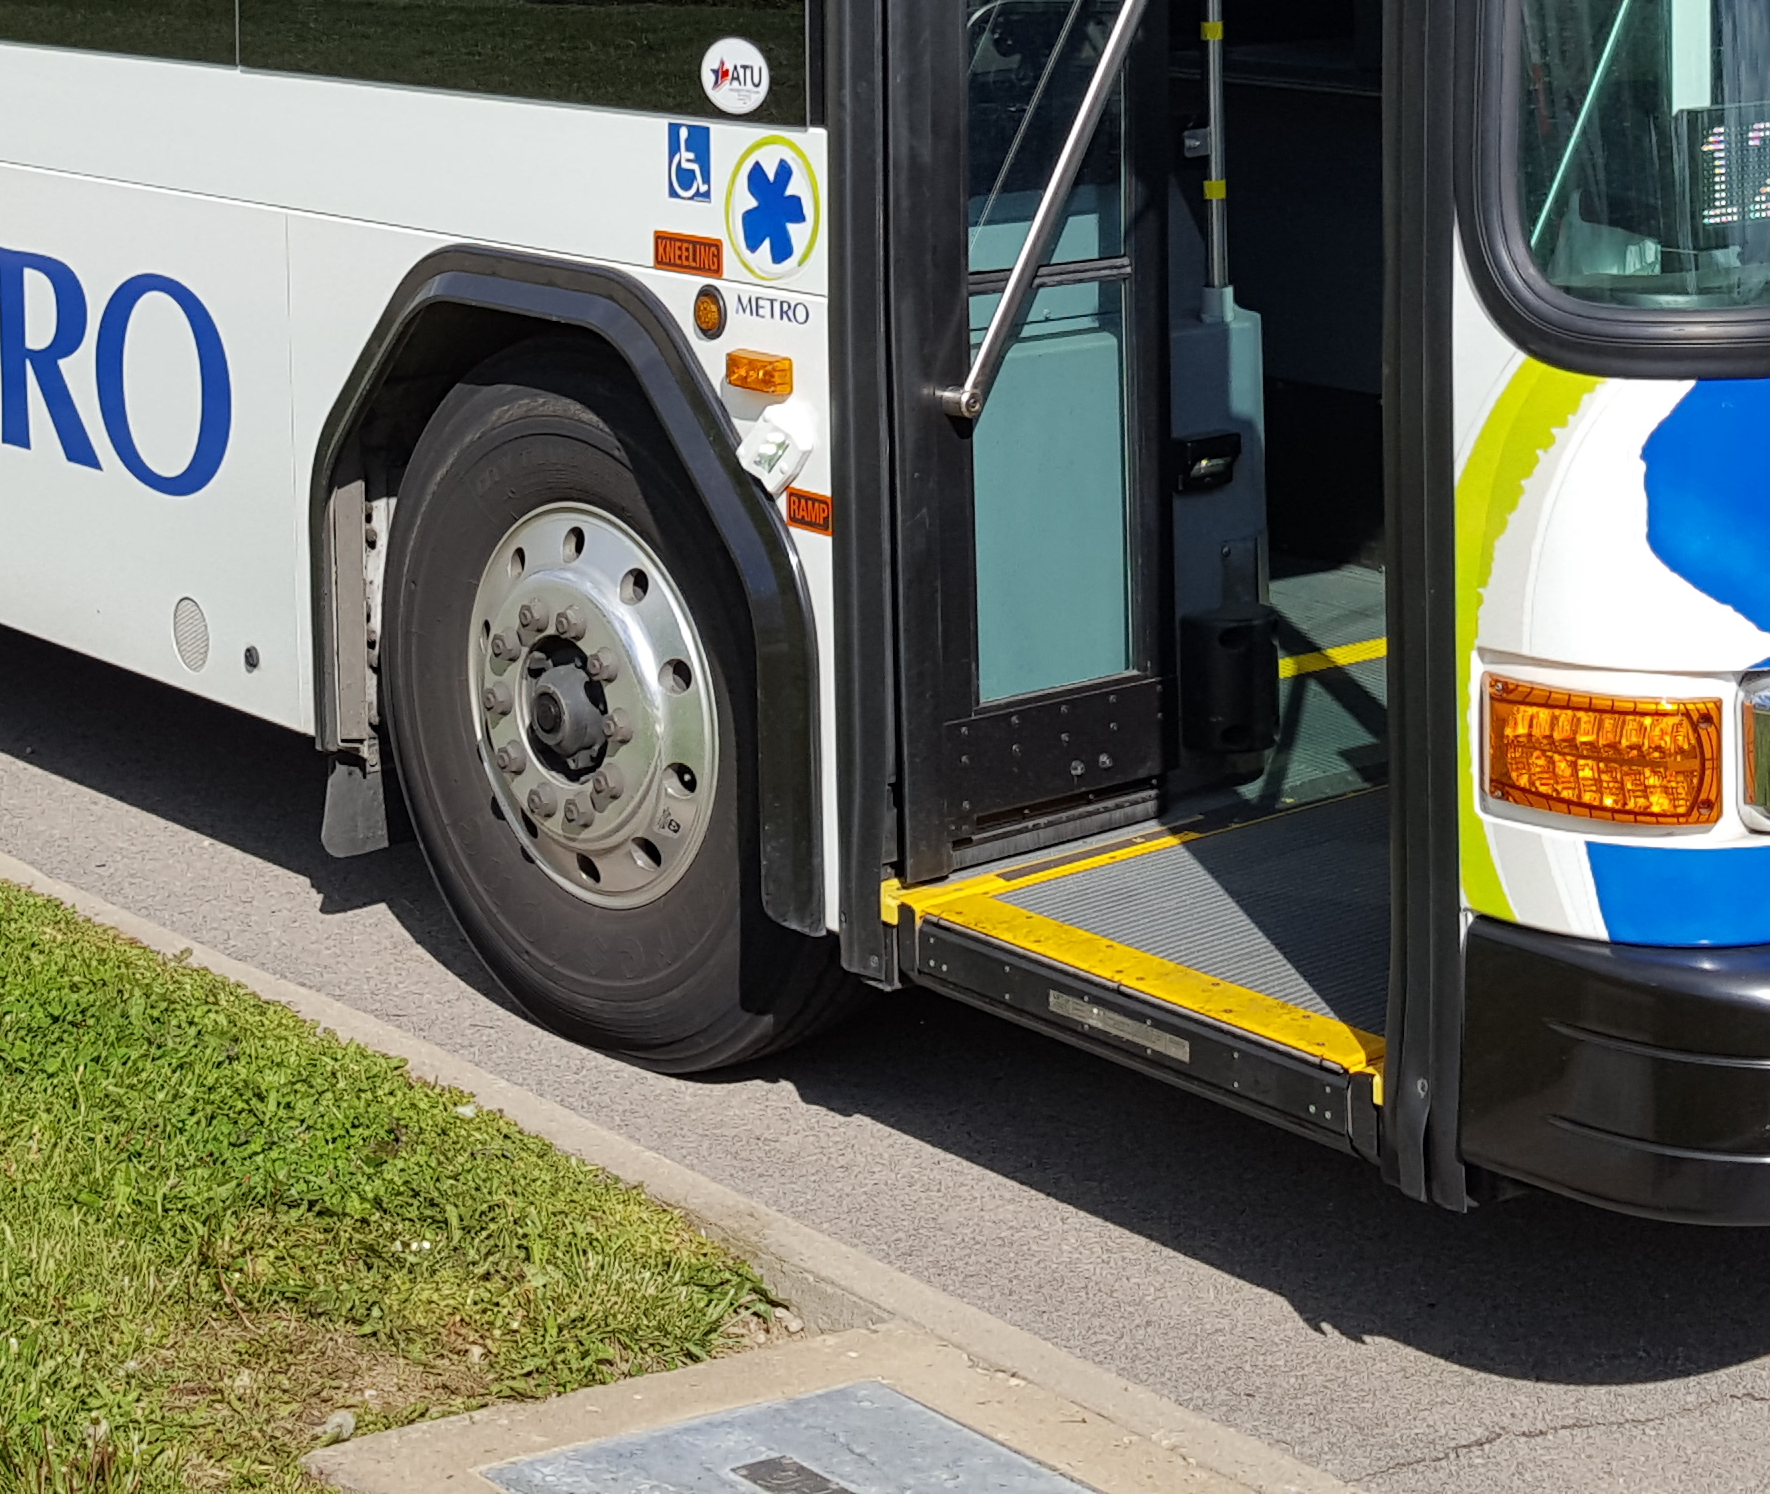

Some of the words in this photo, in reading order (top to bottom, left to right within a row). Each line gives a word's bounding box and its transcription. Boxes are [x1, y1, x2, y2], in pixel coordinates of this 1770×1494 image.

[729, 64, 762, 88] ATU
[657, 238, 719, 270] KNEELING
[734, 293, 810, 325] METRO
[789, 495, 829, 526] RAMP
